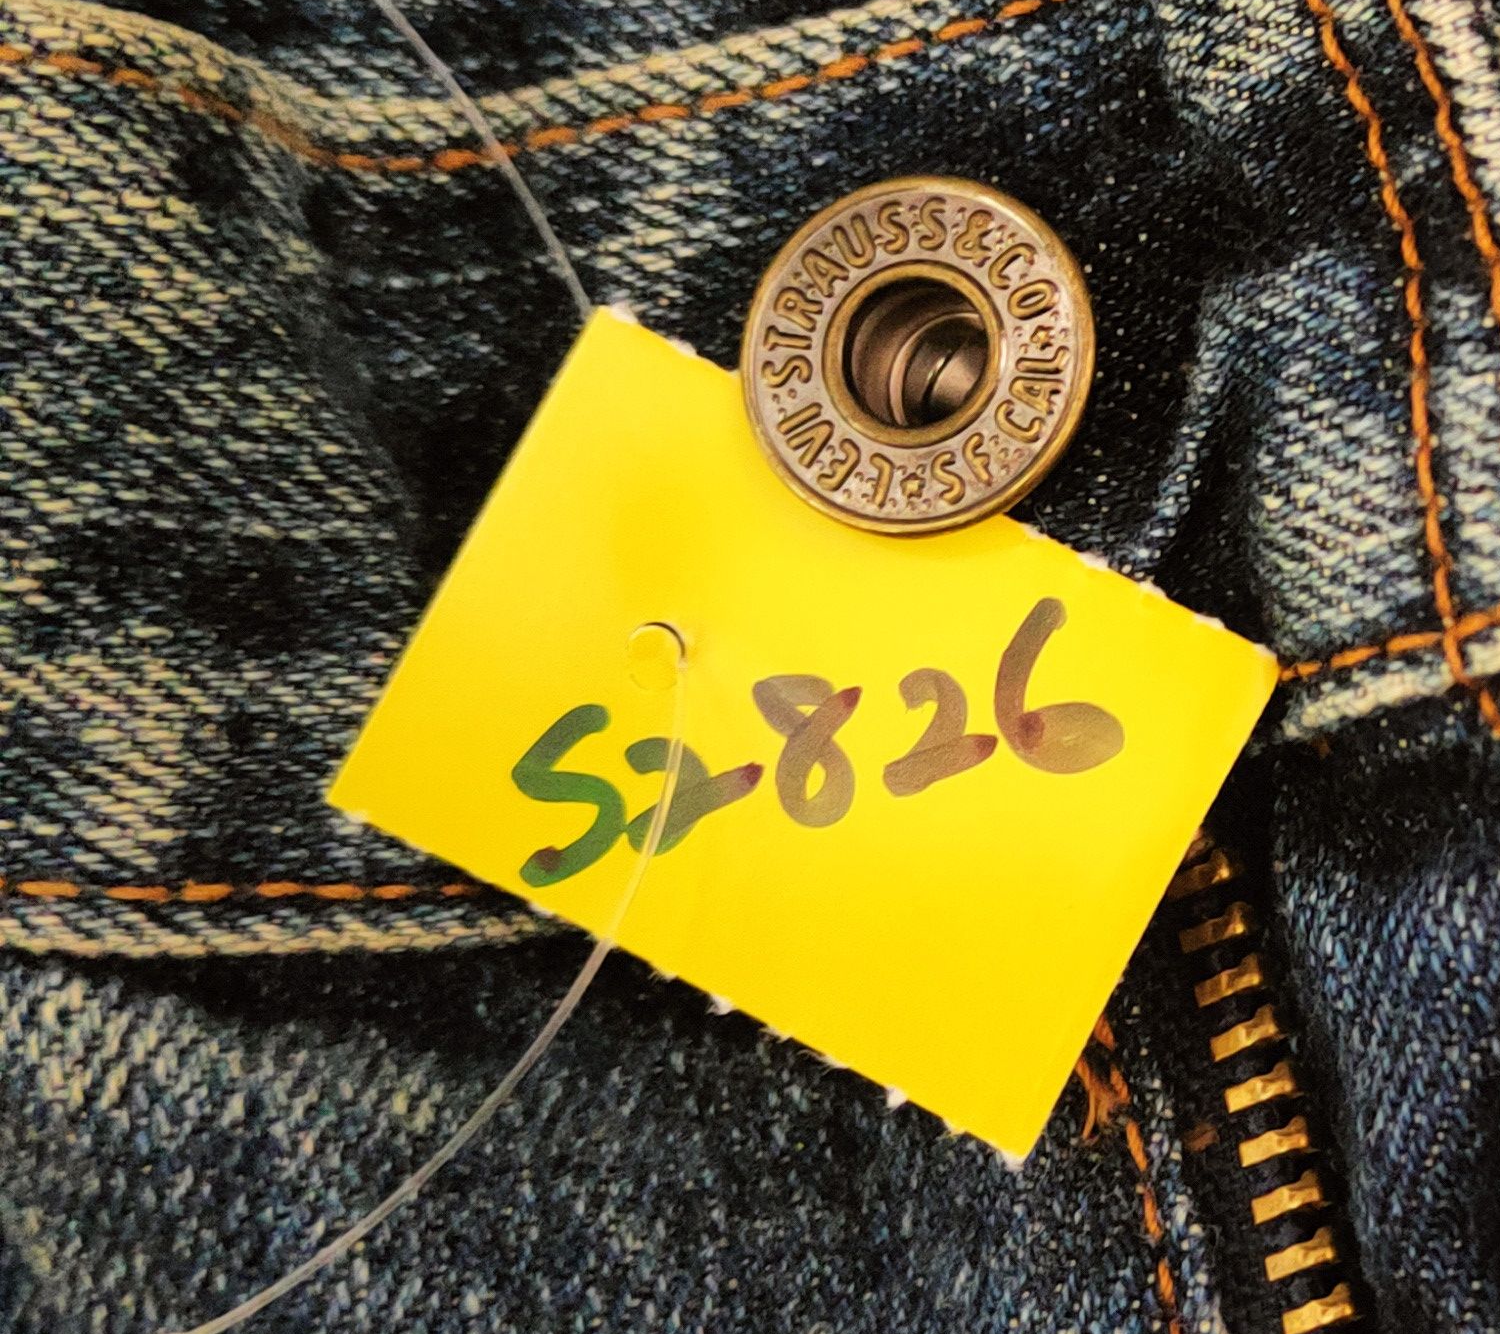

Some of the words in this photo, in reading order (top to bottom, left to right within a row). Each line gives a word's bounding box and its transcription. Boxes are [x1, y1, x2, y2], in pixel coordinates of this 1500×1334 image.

[953, 208, 995, 268] &
[762, 196, 947, 389] STRAUSS
[995, 345, 1071, 444] CAL
[777, 402, 895, 510] LEVI
